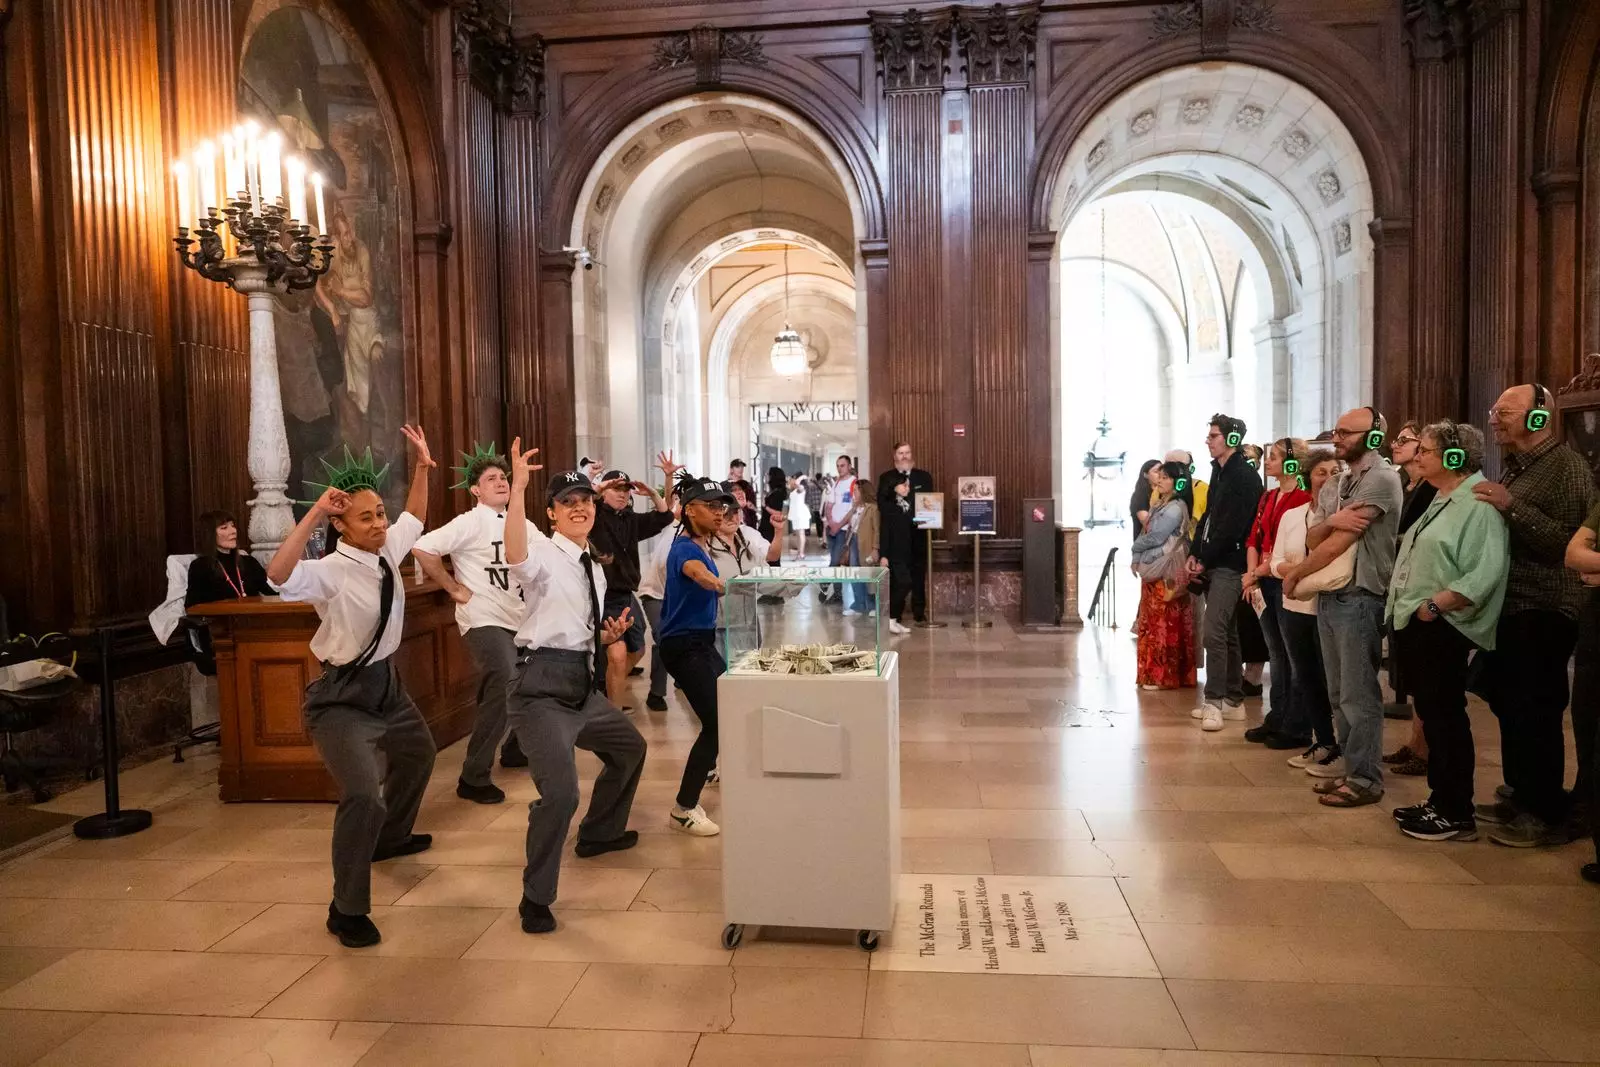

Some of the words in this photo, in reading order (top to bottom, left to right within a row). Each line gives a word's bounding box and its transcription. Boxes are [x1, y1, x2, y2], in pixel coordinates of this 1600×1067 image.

[565, 472, 579, 482] NY
[491, 541, 503, 565] I
[919, 884, 934, 910] Rotunda
[974, 877, 987, 897] McGraw
[959, 897, 968, 919] memory
[999, 893, 1011, 907] from
[1055, 901, 1071, 916] 1986
[978, 906, 992, 925] Louise
[1000, 907, 1016, 918] gift
[919, 912, 935, 940] McGraw
[979, 925, 994, 937] and
[1003, 923, 1020, 948] through
[1064, 927, 1079, 940] May
[956, 928, 971, 950] Named
[1027, 931, 1046, 953] Harold
[919, 942, 935, 957] The
[982, 947, 999, 970] Harold
